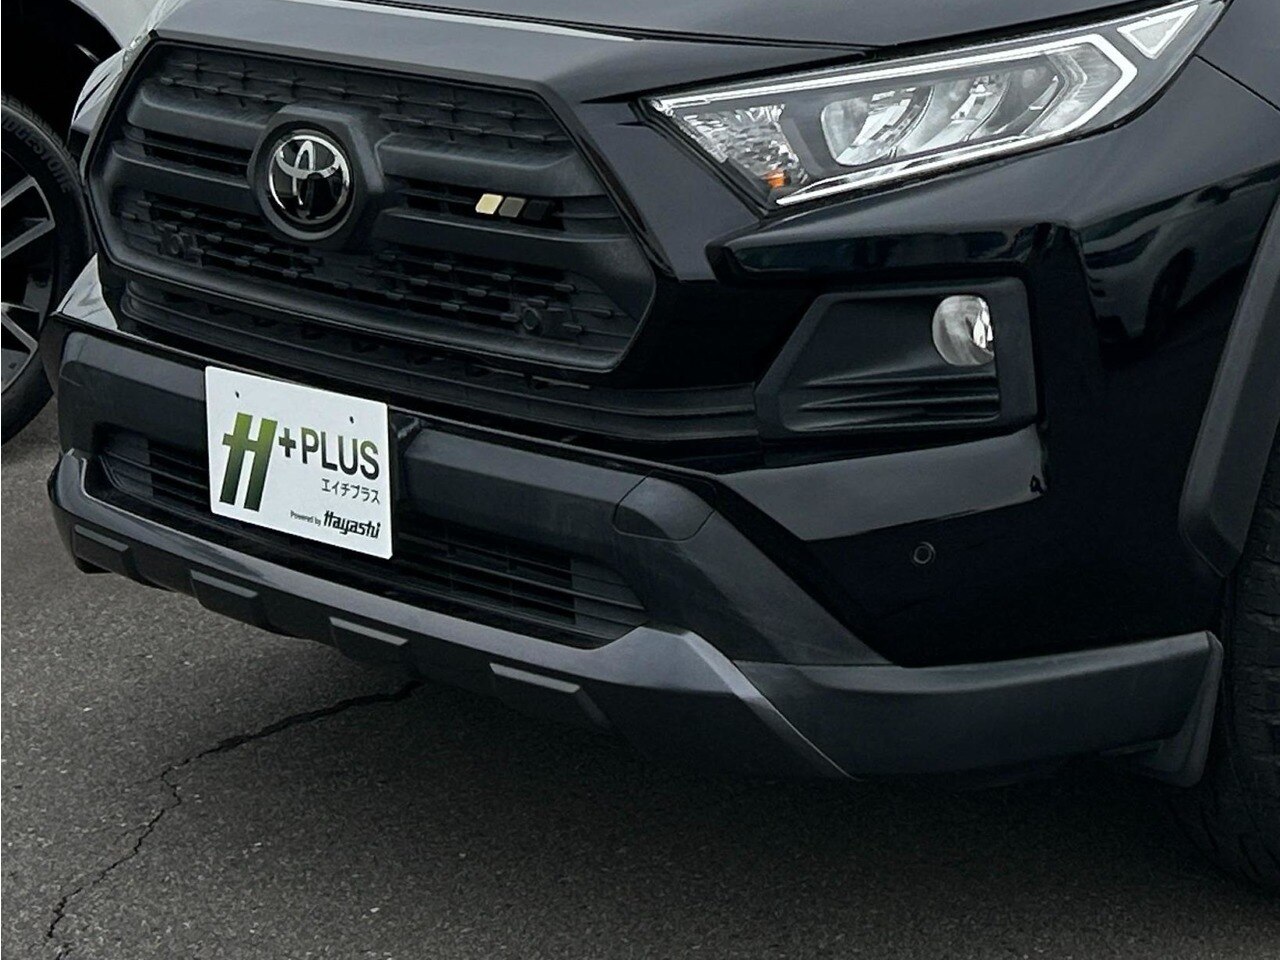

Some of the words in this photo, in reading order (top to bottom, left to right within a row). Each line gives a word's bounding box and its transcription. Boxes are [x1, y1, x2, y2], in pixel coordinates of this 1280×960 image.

[321, 478, 381, 505] エイチプラス
[323, 509, 381, 539] Hayashi
